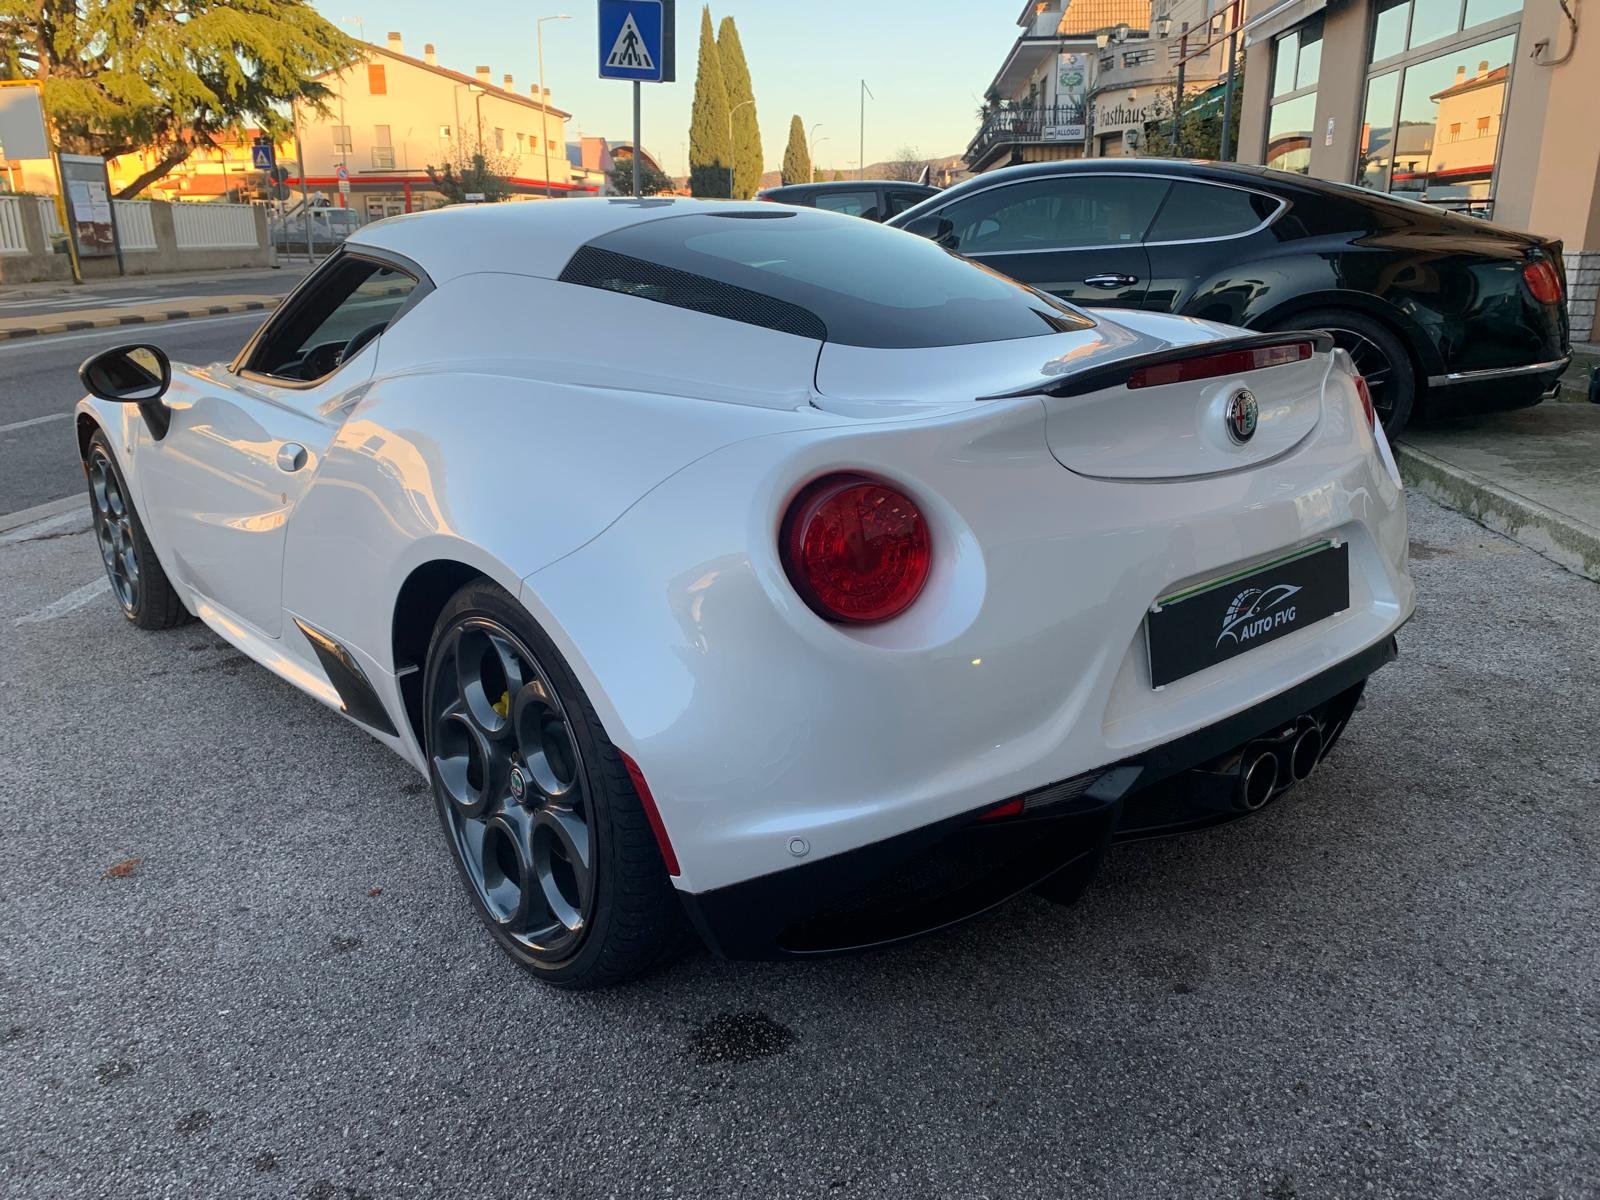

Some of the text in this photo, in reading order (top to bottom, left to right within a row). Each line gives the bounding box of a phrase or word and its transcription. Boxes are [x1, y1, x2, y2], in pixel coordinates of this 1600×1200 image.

[1056, 128, 1081, 137] ALLOGGI
[1240, 606, 1296, 642] AUTO FVG
